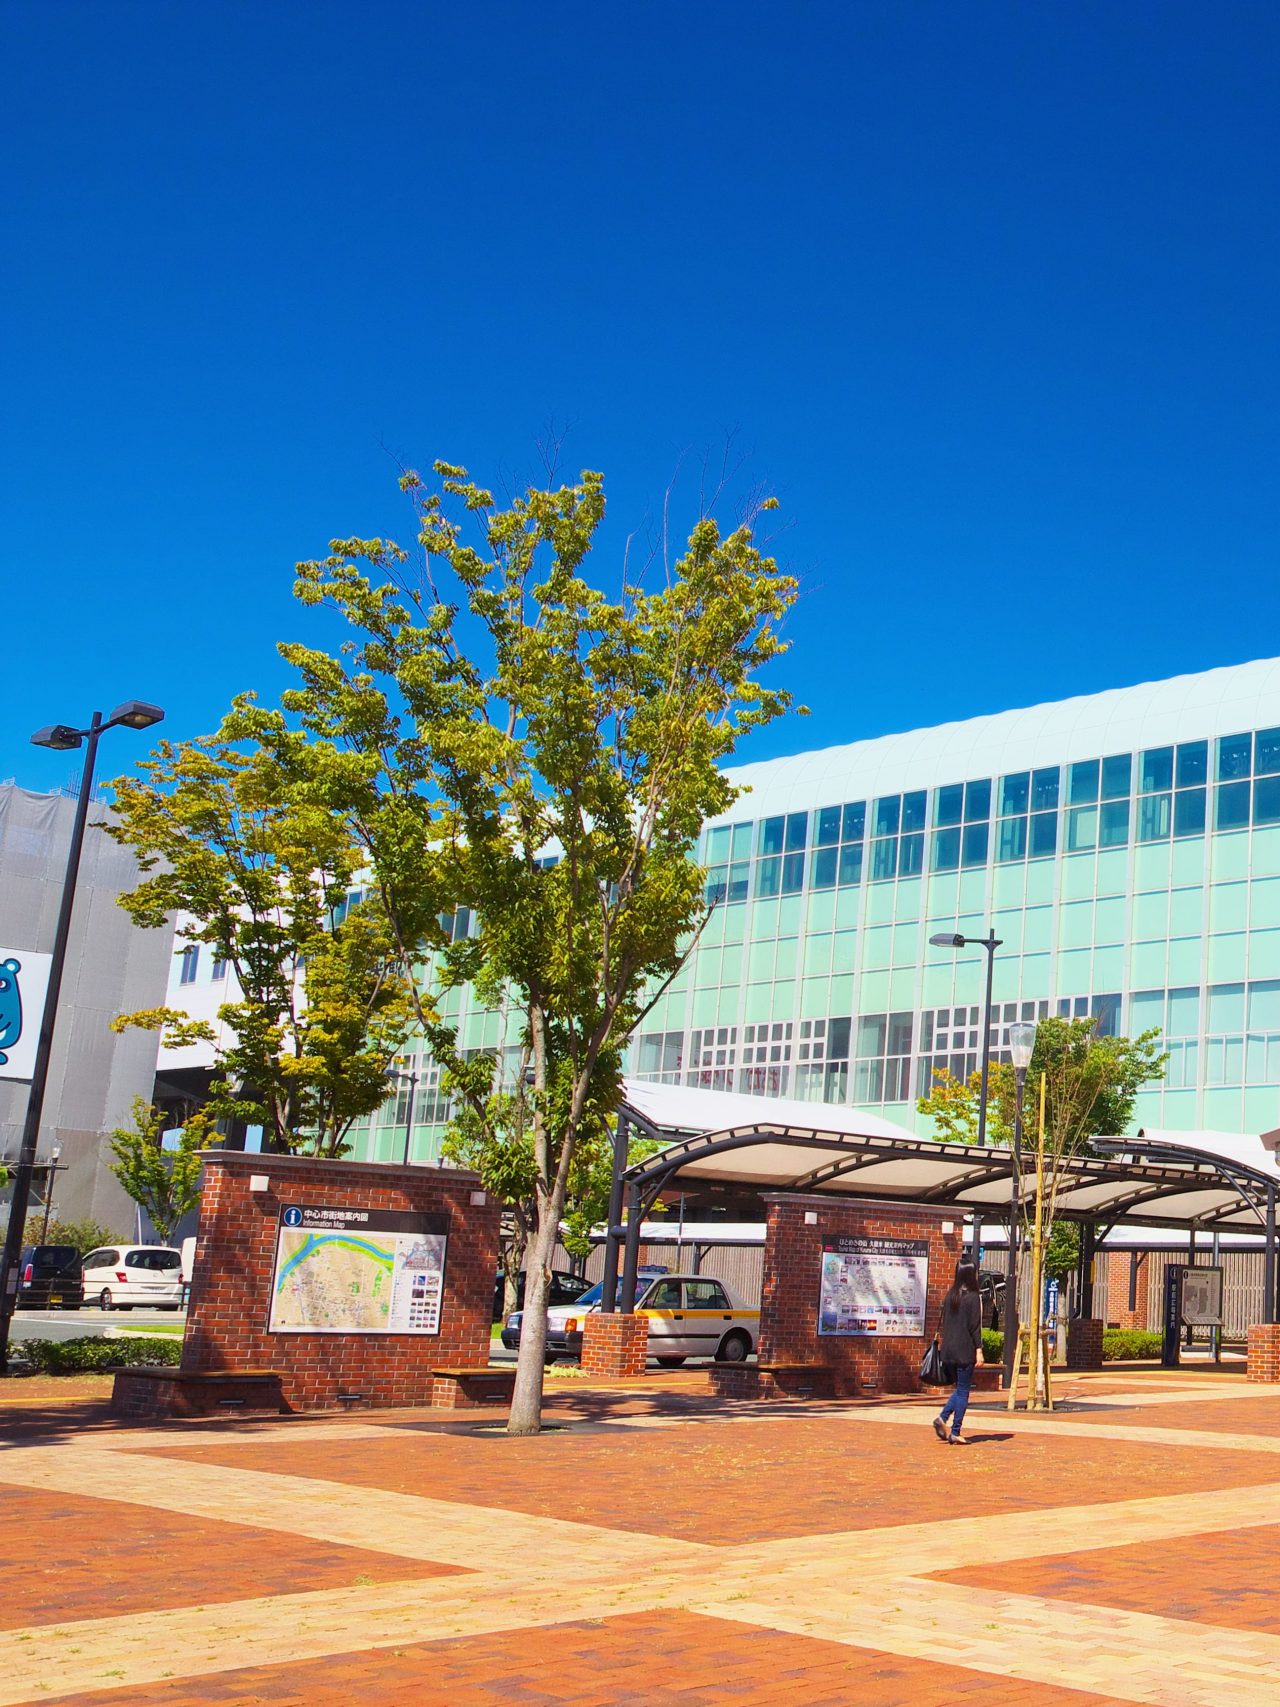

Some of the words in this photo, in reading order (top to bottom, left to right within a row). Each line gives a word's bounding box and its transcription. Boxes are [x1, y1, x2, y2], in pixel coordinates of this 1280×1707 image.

[304, 1209, 368, 1222] 中心市街地案内図
[303, 1220, 332, 1228] Information
[333, 1221, 345, 1229] Map
